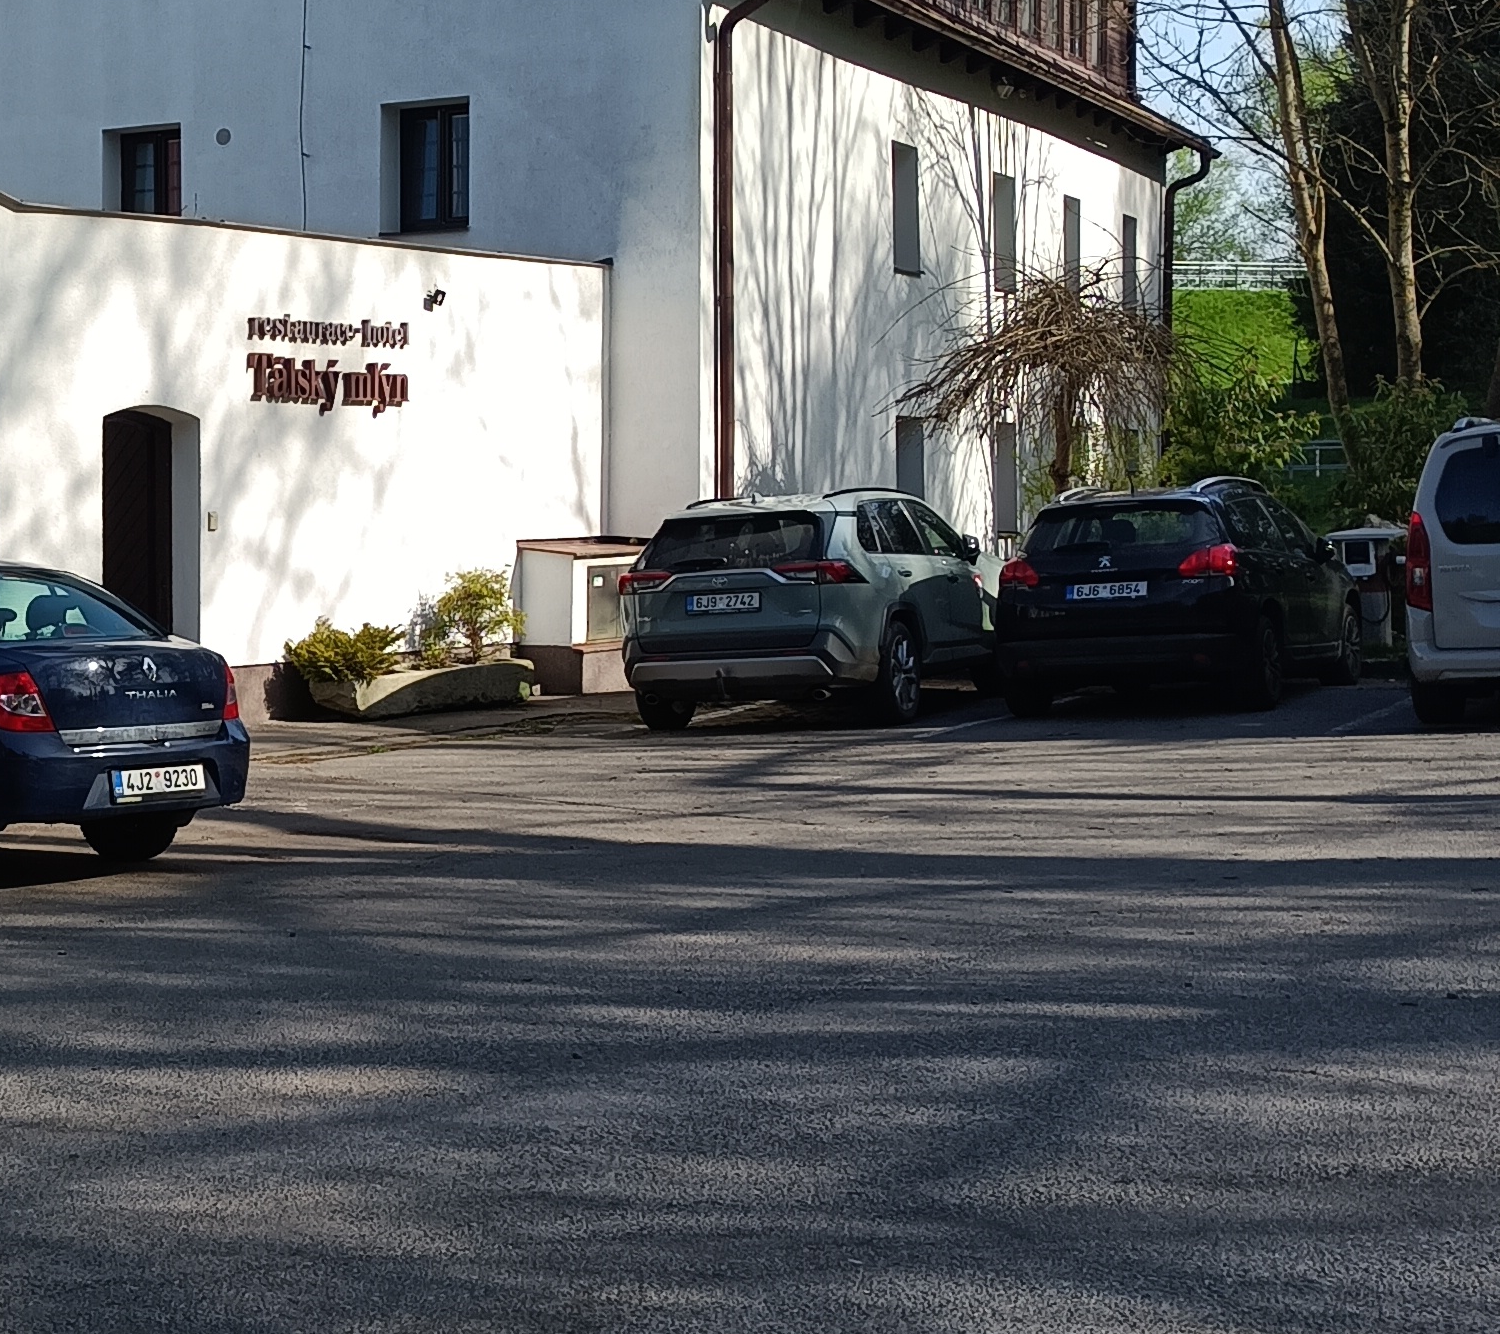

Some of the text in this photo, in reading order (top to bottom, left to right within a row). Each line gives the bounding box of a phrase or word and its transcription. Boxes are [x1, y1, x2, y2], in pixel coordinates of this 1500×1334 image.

[247, 314, 410, 349] restaurace-hotel
[246, 352, 410, 419] Tálský mlýn
[1076, 582, 1141, 598] 6J6 6854
[696, 596, 718, 609] 6J9
[725, 594, 755, 608] 2742
[124, 688, 178, 700] THALIA
[126, 768, 198, 792] 4J2 9230
